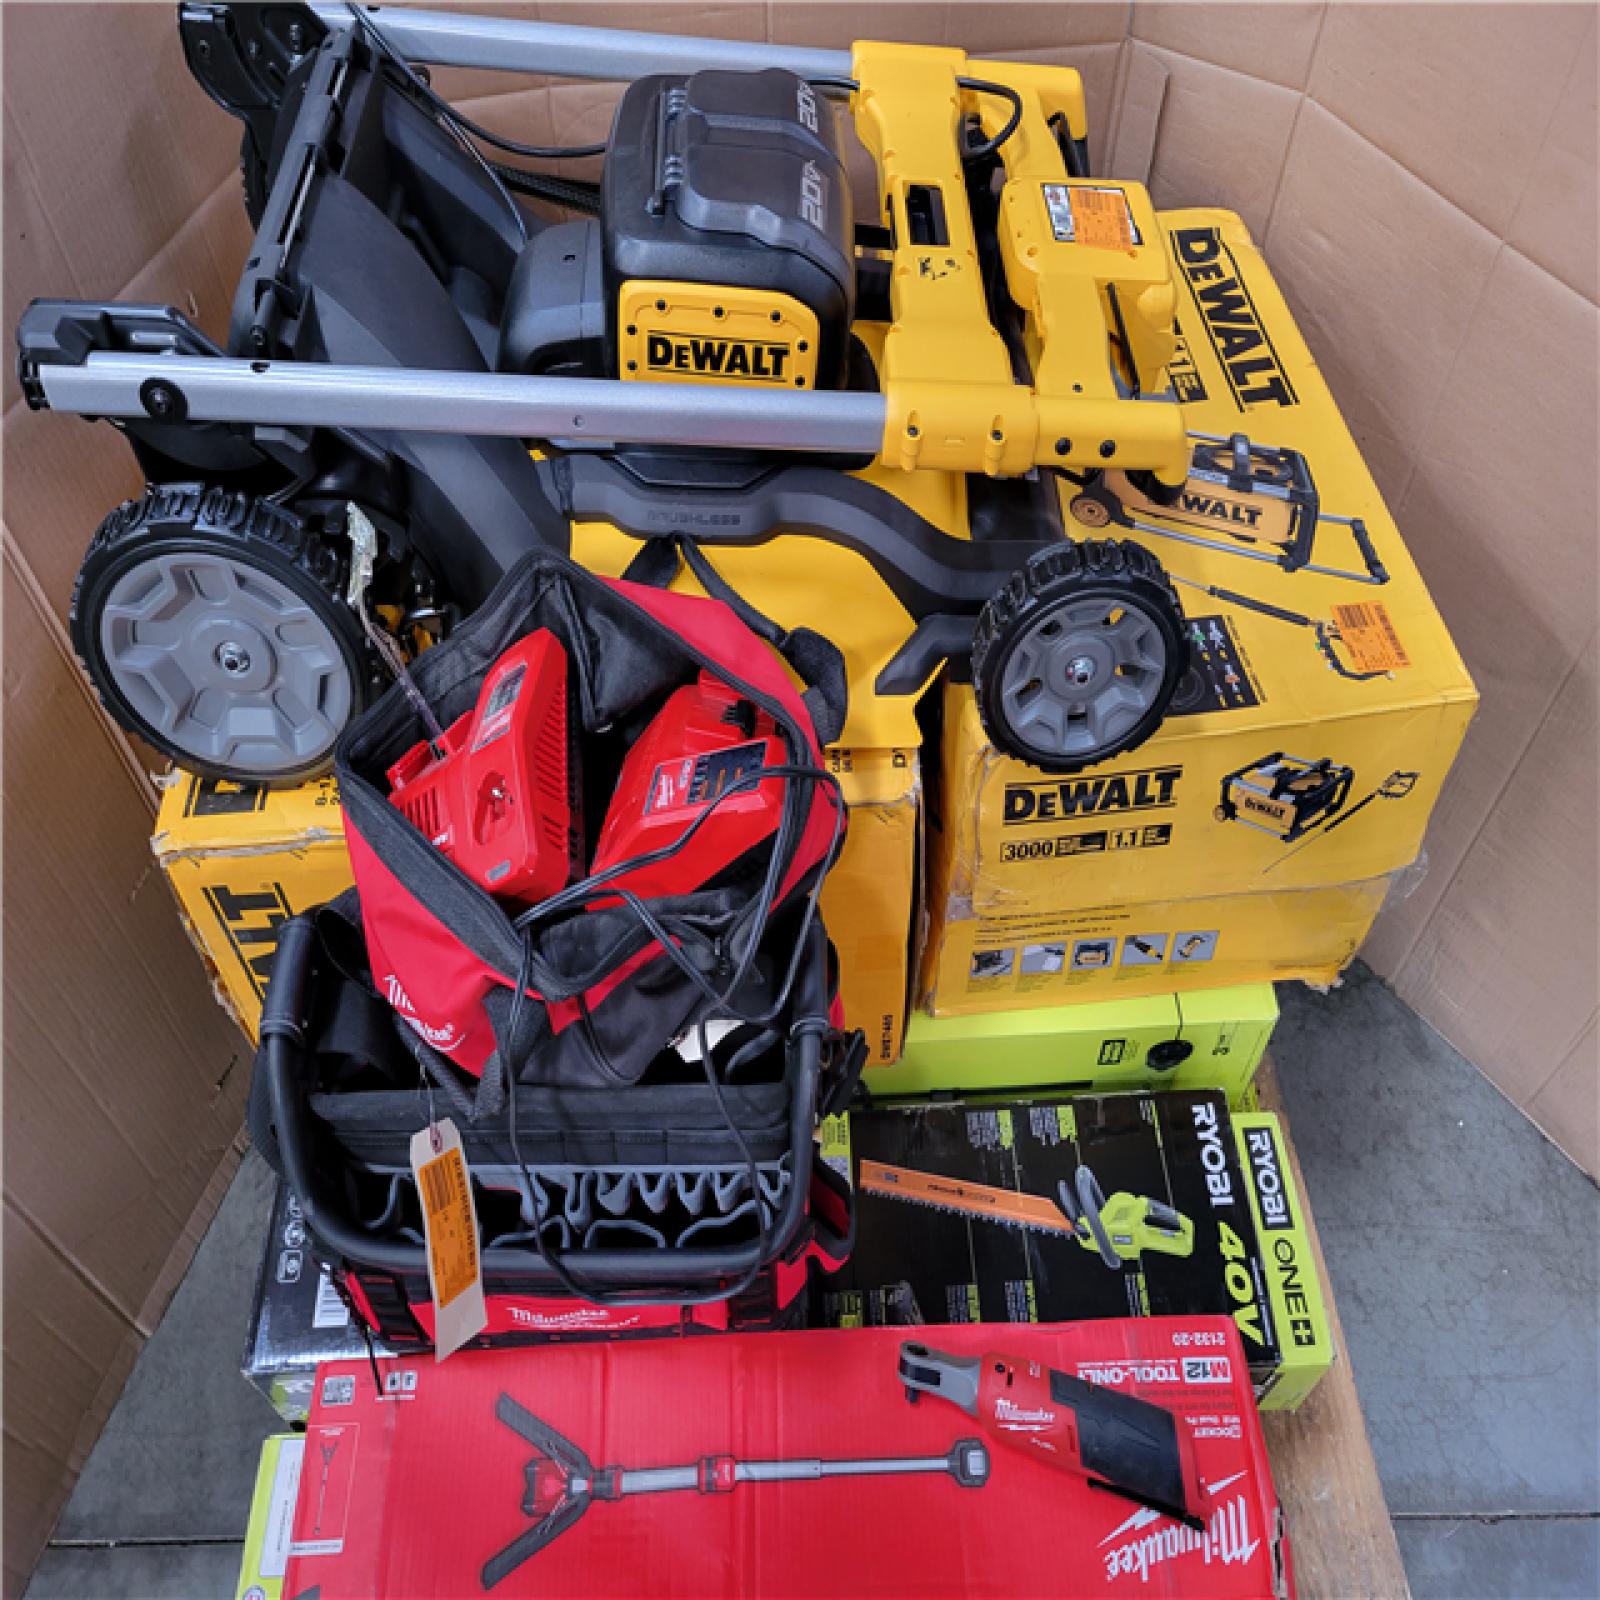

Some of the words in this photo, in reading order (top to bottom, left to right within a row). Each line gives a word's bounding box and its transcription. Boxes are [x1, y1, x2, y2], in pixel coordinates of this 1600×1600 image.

[1183, 494, 1263, 526] WALT
[1004, 840, 1053, 862] 3000
[1116, 831, 1137, 848] 1.1
[1247, 1129, 1288, 1228] RYOBI
[1191, 1103, 1233, 1207] RYOBI
[1217, 1221, 1265, 1347] 40V
[1105, 1495, 1261, 1582] Milwaukee
